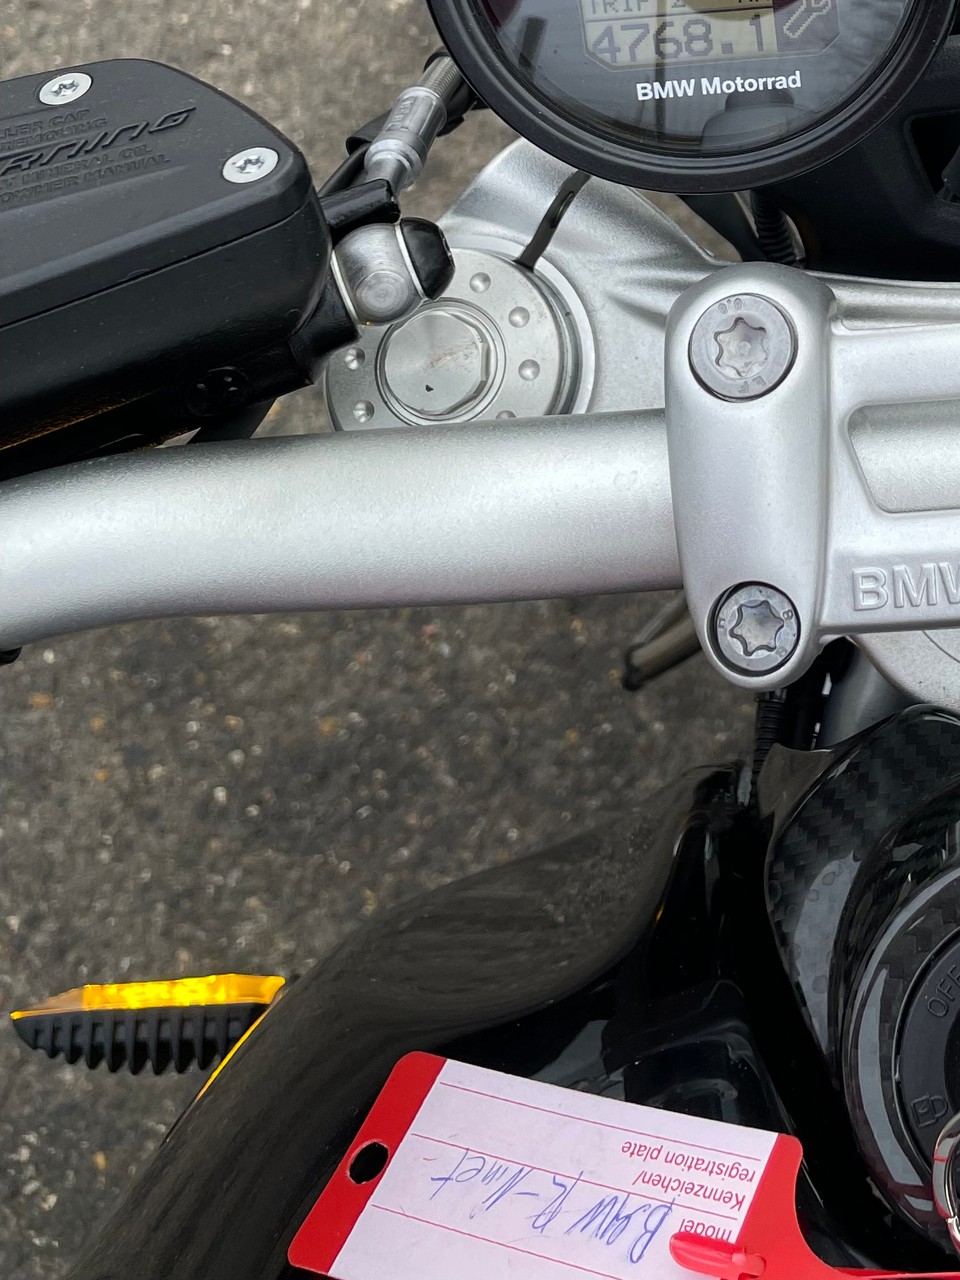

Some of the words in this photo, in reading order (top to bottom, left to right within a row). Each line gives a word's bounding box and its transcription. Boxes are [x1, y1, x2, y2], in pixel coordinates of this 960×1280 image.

[591, 14, 764, 64] 4768.1
[636, 78, 696, 102] BMW
[701, 70, 802, 95] Motorrad
[621, 1139, 662, 1167] plate
[664, 1150, 756, 1183] registration
[632, 1171, 747, 1210] Kennzeichen/
